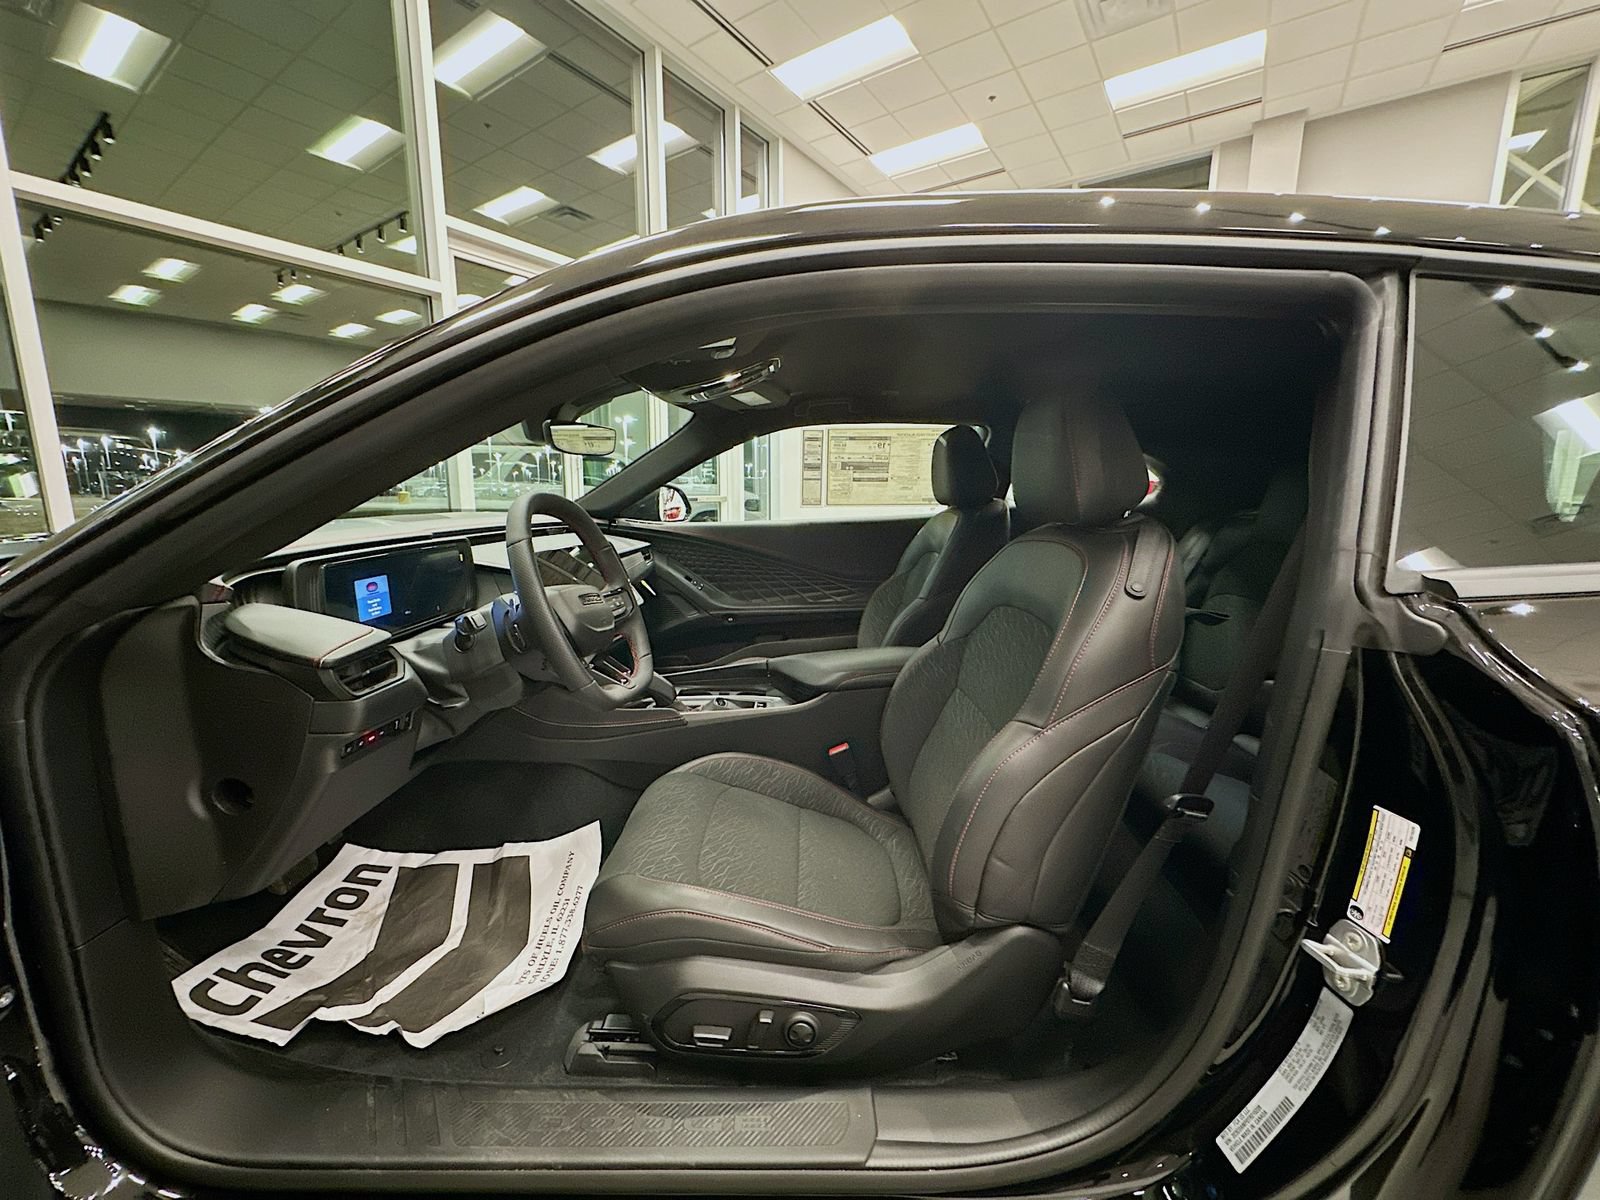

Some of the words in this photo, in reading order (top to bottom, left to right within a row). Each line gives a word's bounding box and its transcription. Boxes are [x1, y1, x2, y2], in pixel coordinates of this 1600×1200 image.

[189, 864, 392, 1016] Chevron
[528, 953, 537, 966] OF
[550, 899, 560, 914] OIL
[557, 851, 574, 895] COMPANY
